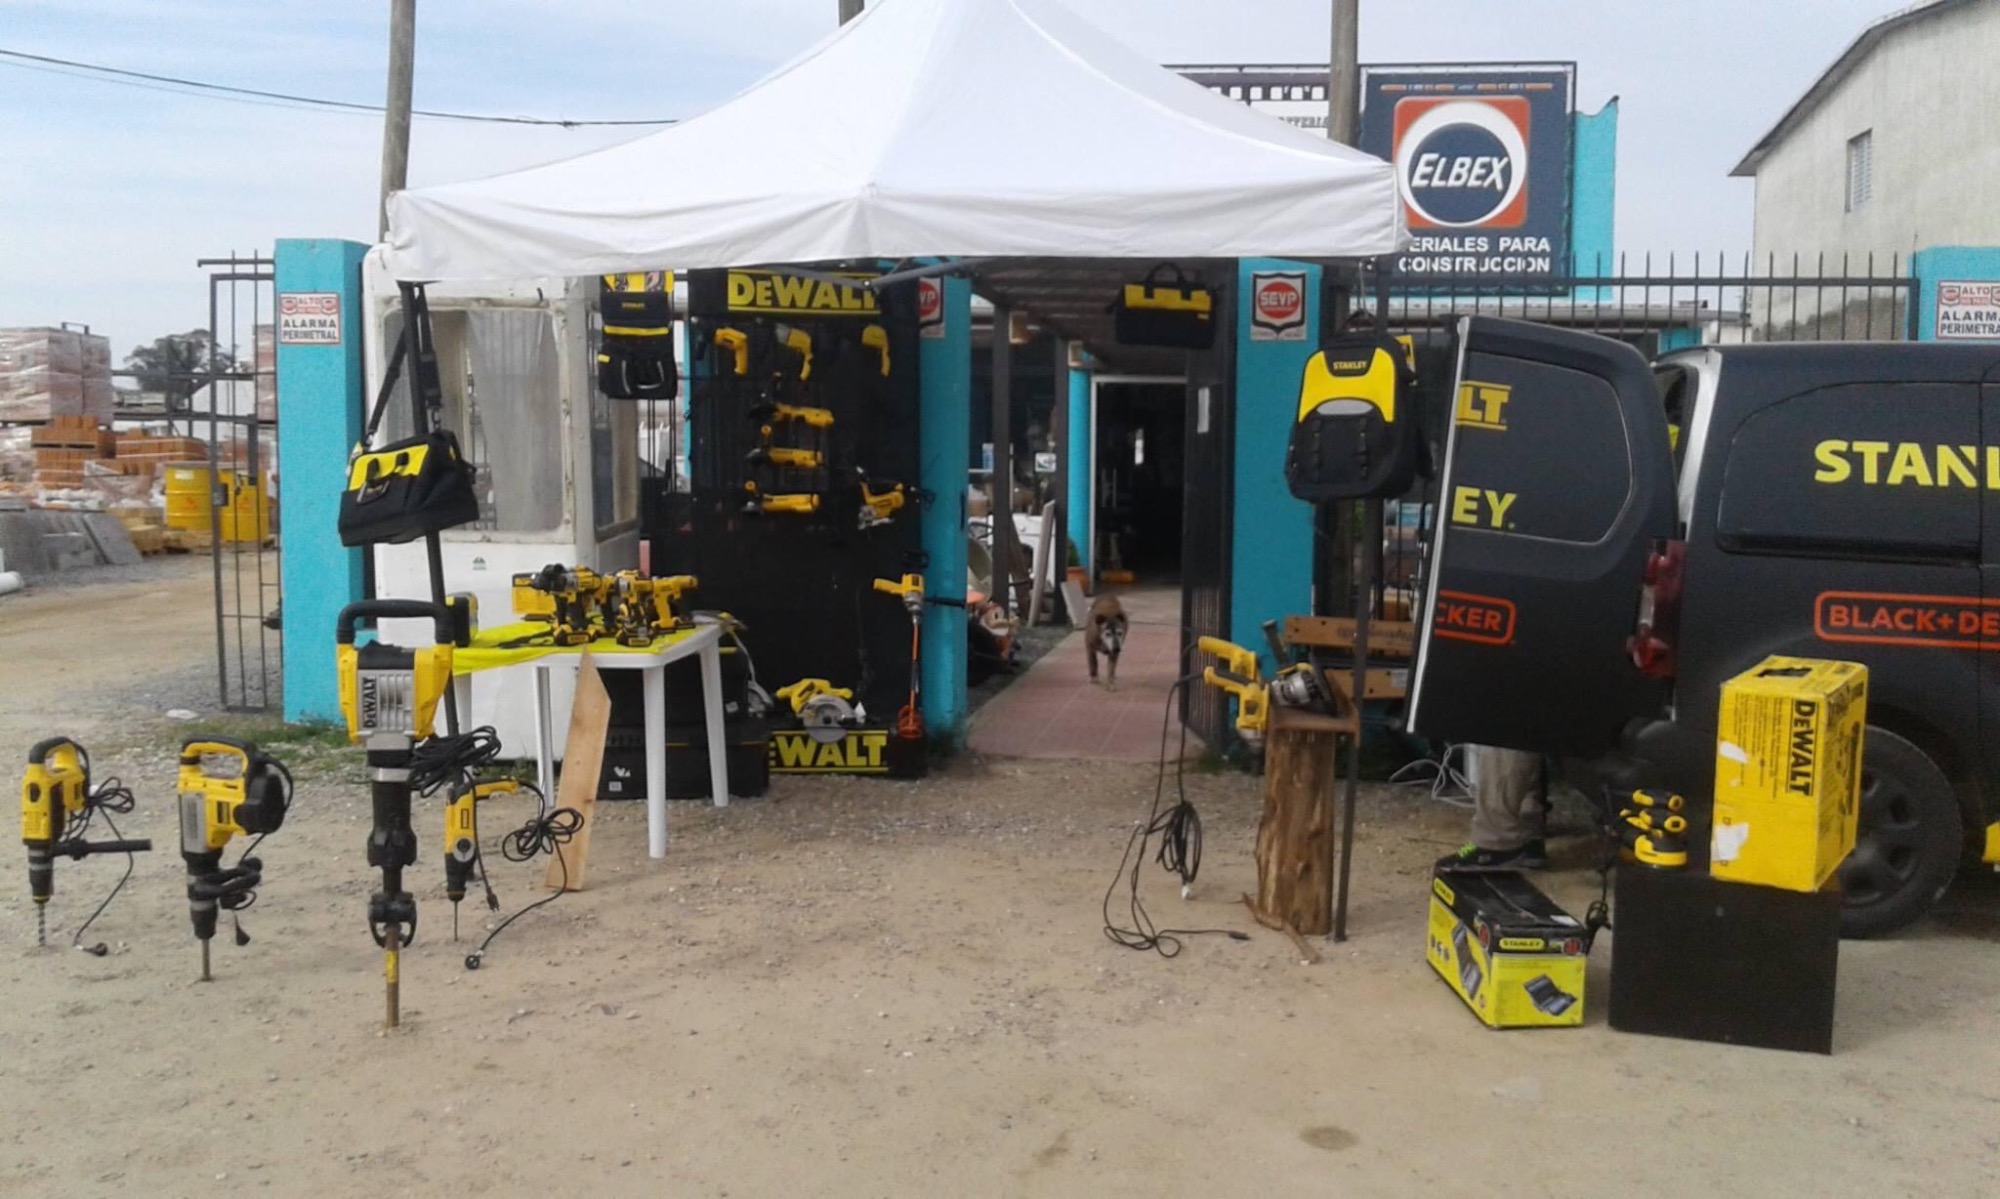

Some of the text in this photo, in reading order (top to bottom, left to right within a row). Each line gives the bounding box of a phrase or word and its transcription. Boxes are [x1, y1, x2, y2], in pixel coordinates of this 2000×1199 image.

[1411, 153, 1508, 191] ELBEX
[1499, 237, 1550, 253] PARA
[1962, 287, 1989, 295] ALTO
[283, 319, 336, 328] ALARMA
[283, 330, 336, 339] PERIMETRAL
[1333, 361, 1367, 370] STANLEY
